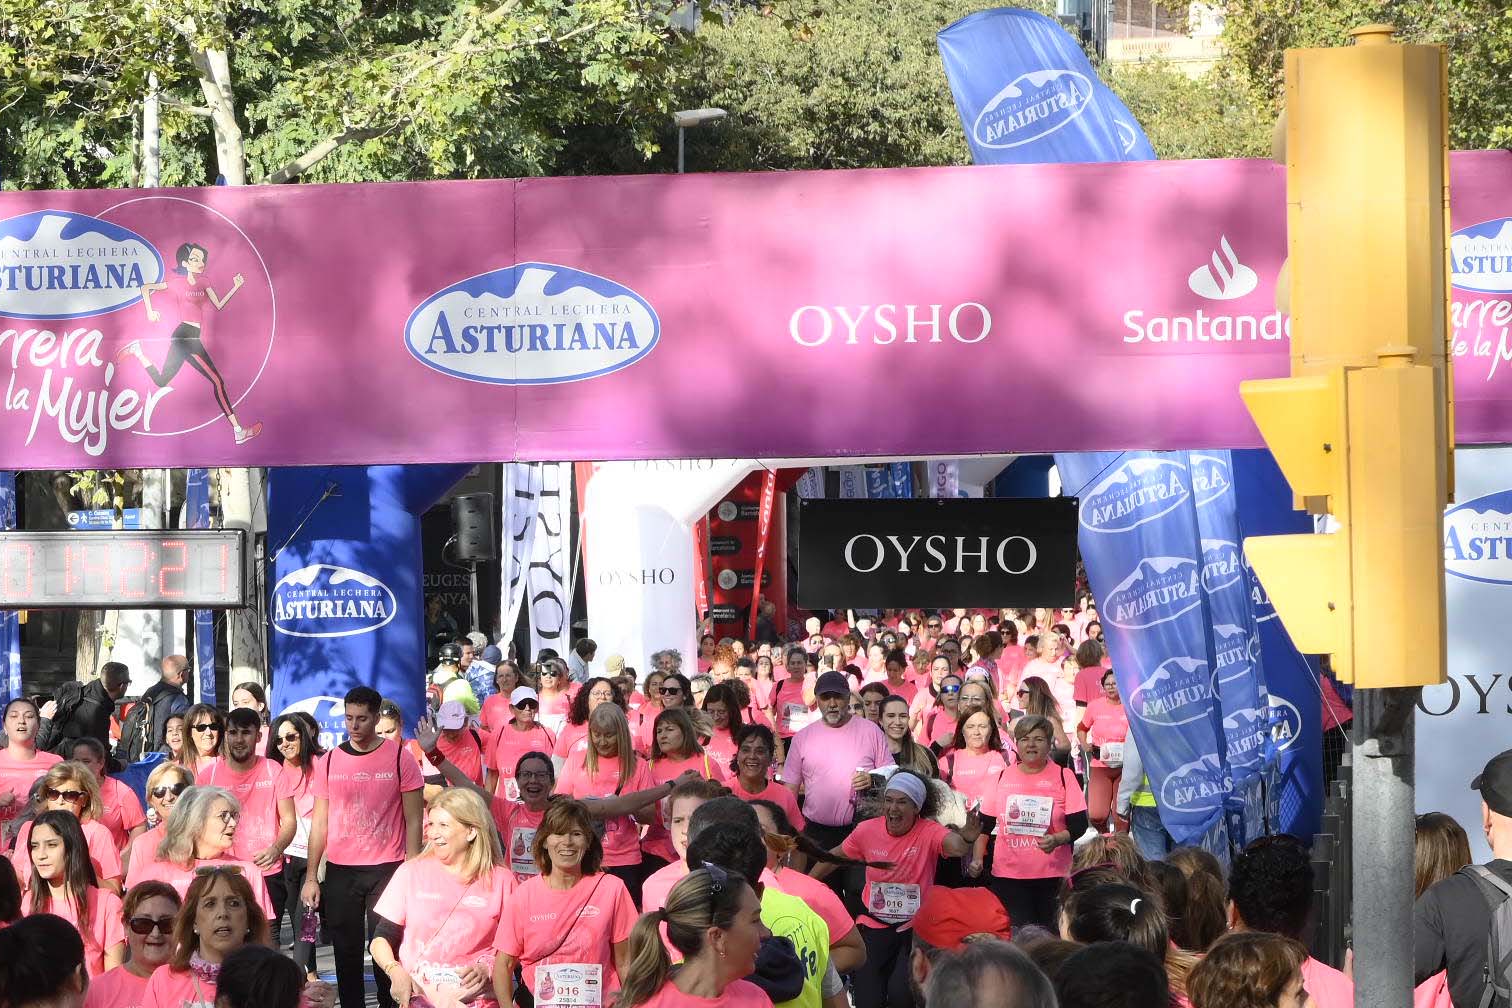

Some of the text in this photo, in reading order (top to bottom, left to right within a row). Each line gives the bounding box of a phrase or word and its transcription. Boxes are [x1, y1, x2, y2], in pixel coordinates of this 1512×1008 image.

[66, 246, 140, 258] LECHERA
[463, 303, 633, 318] CENTRAL LECHERA
[788, 302, 993, 347] OYSHO
[1122, 308, 1290, 343] Santand
[424, 310, 641, 356] ASTURIANA
[4, 372, 30, 412] la
[24, 364, 175, 457] Mujer
[844, 533, 1038, 575] OYSHO
[275, 592, 387, 620] ASTURIANA
[287, 588, 382, 597] CENTRAL LECHERA
[557, 986, 580, 996] 016
